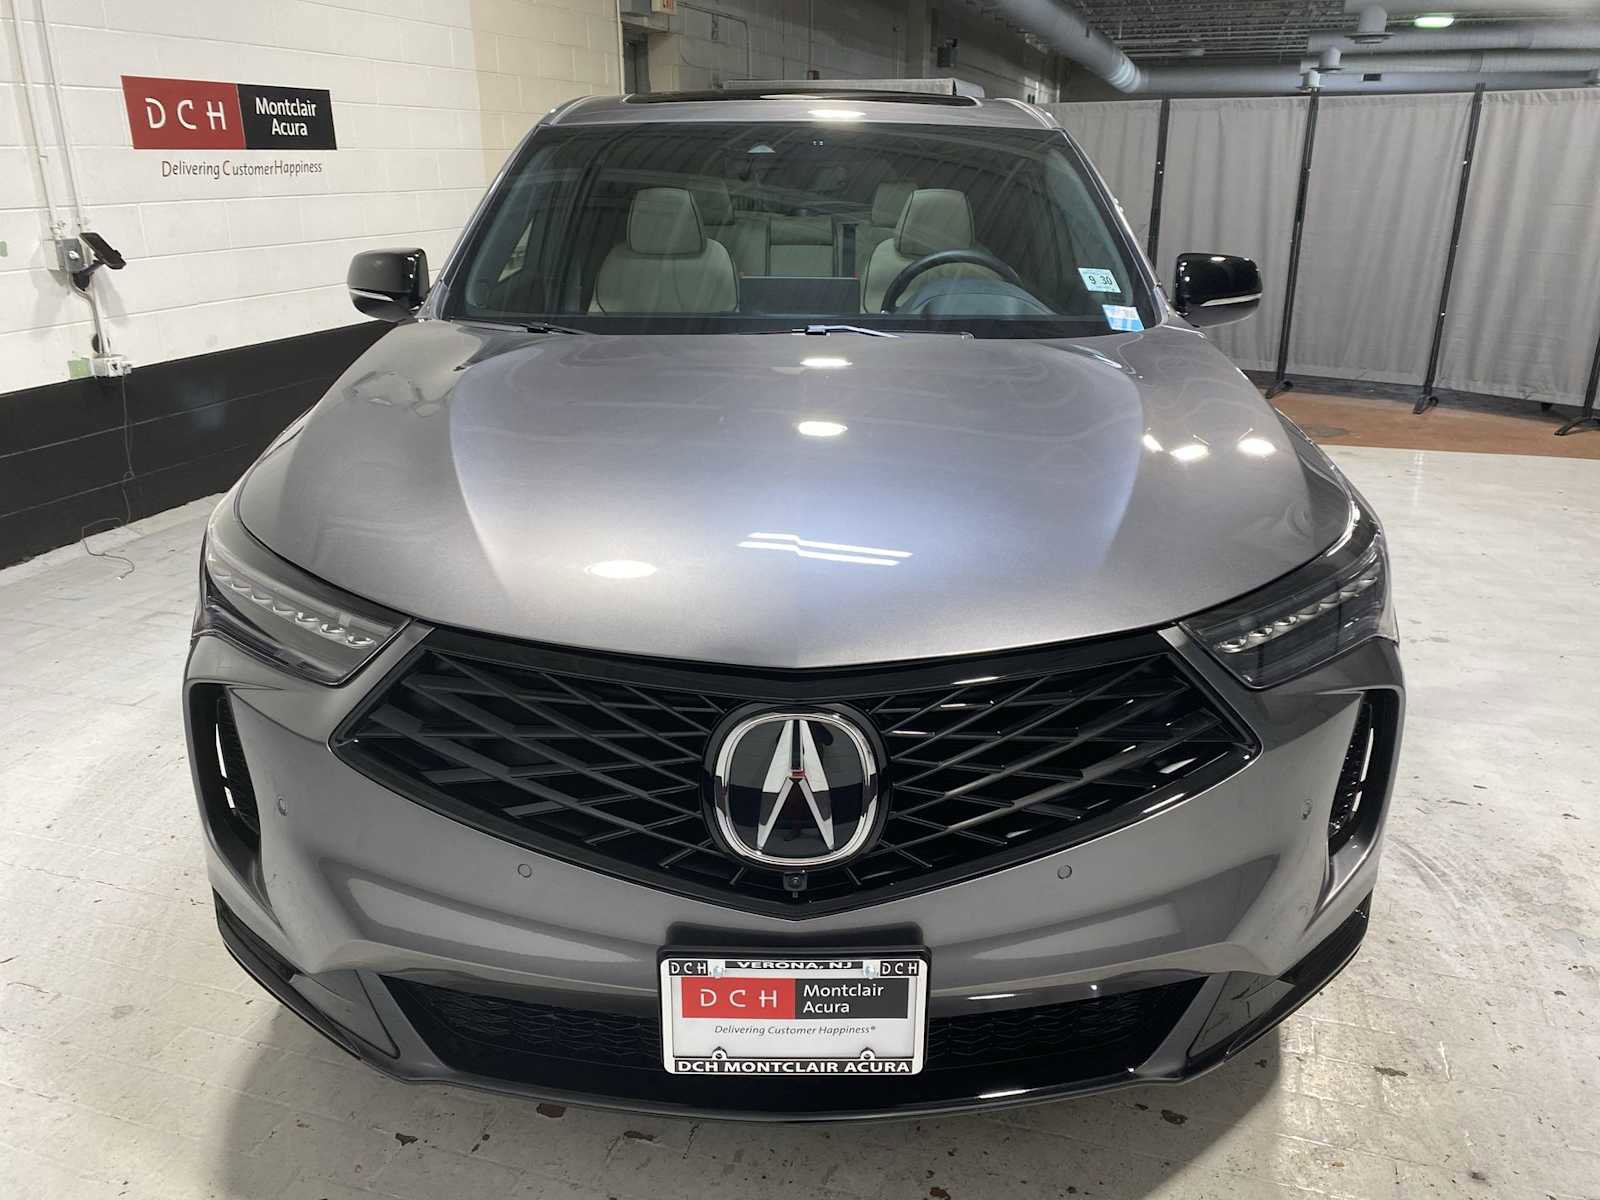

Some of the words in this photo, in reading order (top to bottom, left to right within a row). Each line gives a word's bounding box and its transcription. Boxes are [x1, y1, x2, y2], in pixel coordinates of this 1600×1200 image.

[255, 97, 317, 117] Montclair
[271, 118, 308, 136] Acura
[161, 160, 220, 179] Delivering
[1088, 275, 1097, 285] 9
[671, 962, 706, 974] DCH
[881, 962, 917, 974] DCH
[803, 983, 884, 997] Montclair
[700, 988, 777, 1008] DCH
[802, 1000, 850, 1013] Acura
[714, 1025, 765, 1036] Delivering
[767, 1026, 816, 1035] Customer
[678, 1061, 718, 1073] DCH
[724, 1061, 839, 1073] MONTCLAIR
[843, 1061, 910, 1073] ACURA
